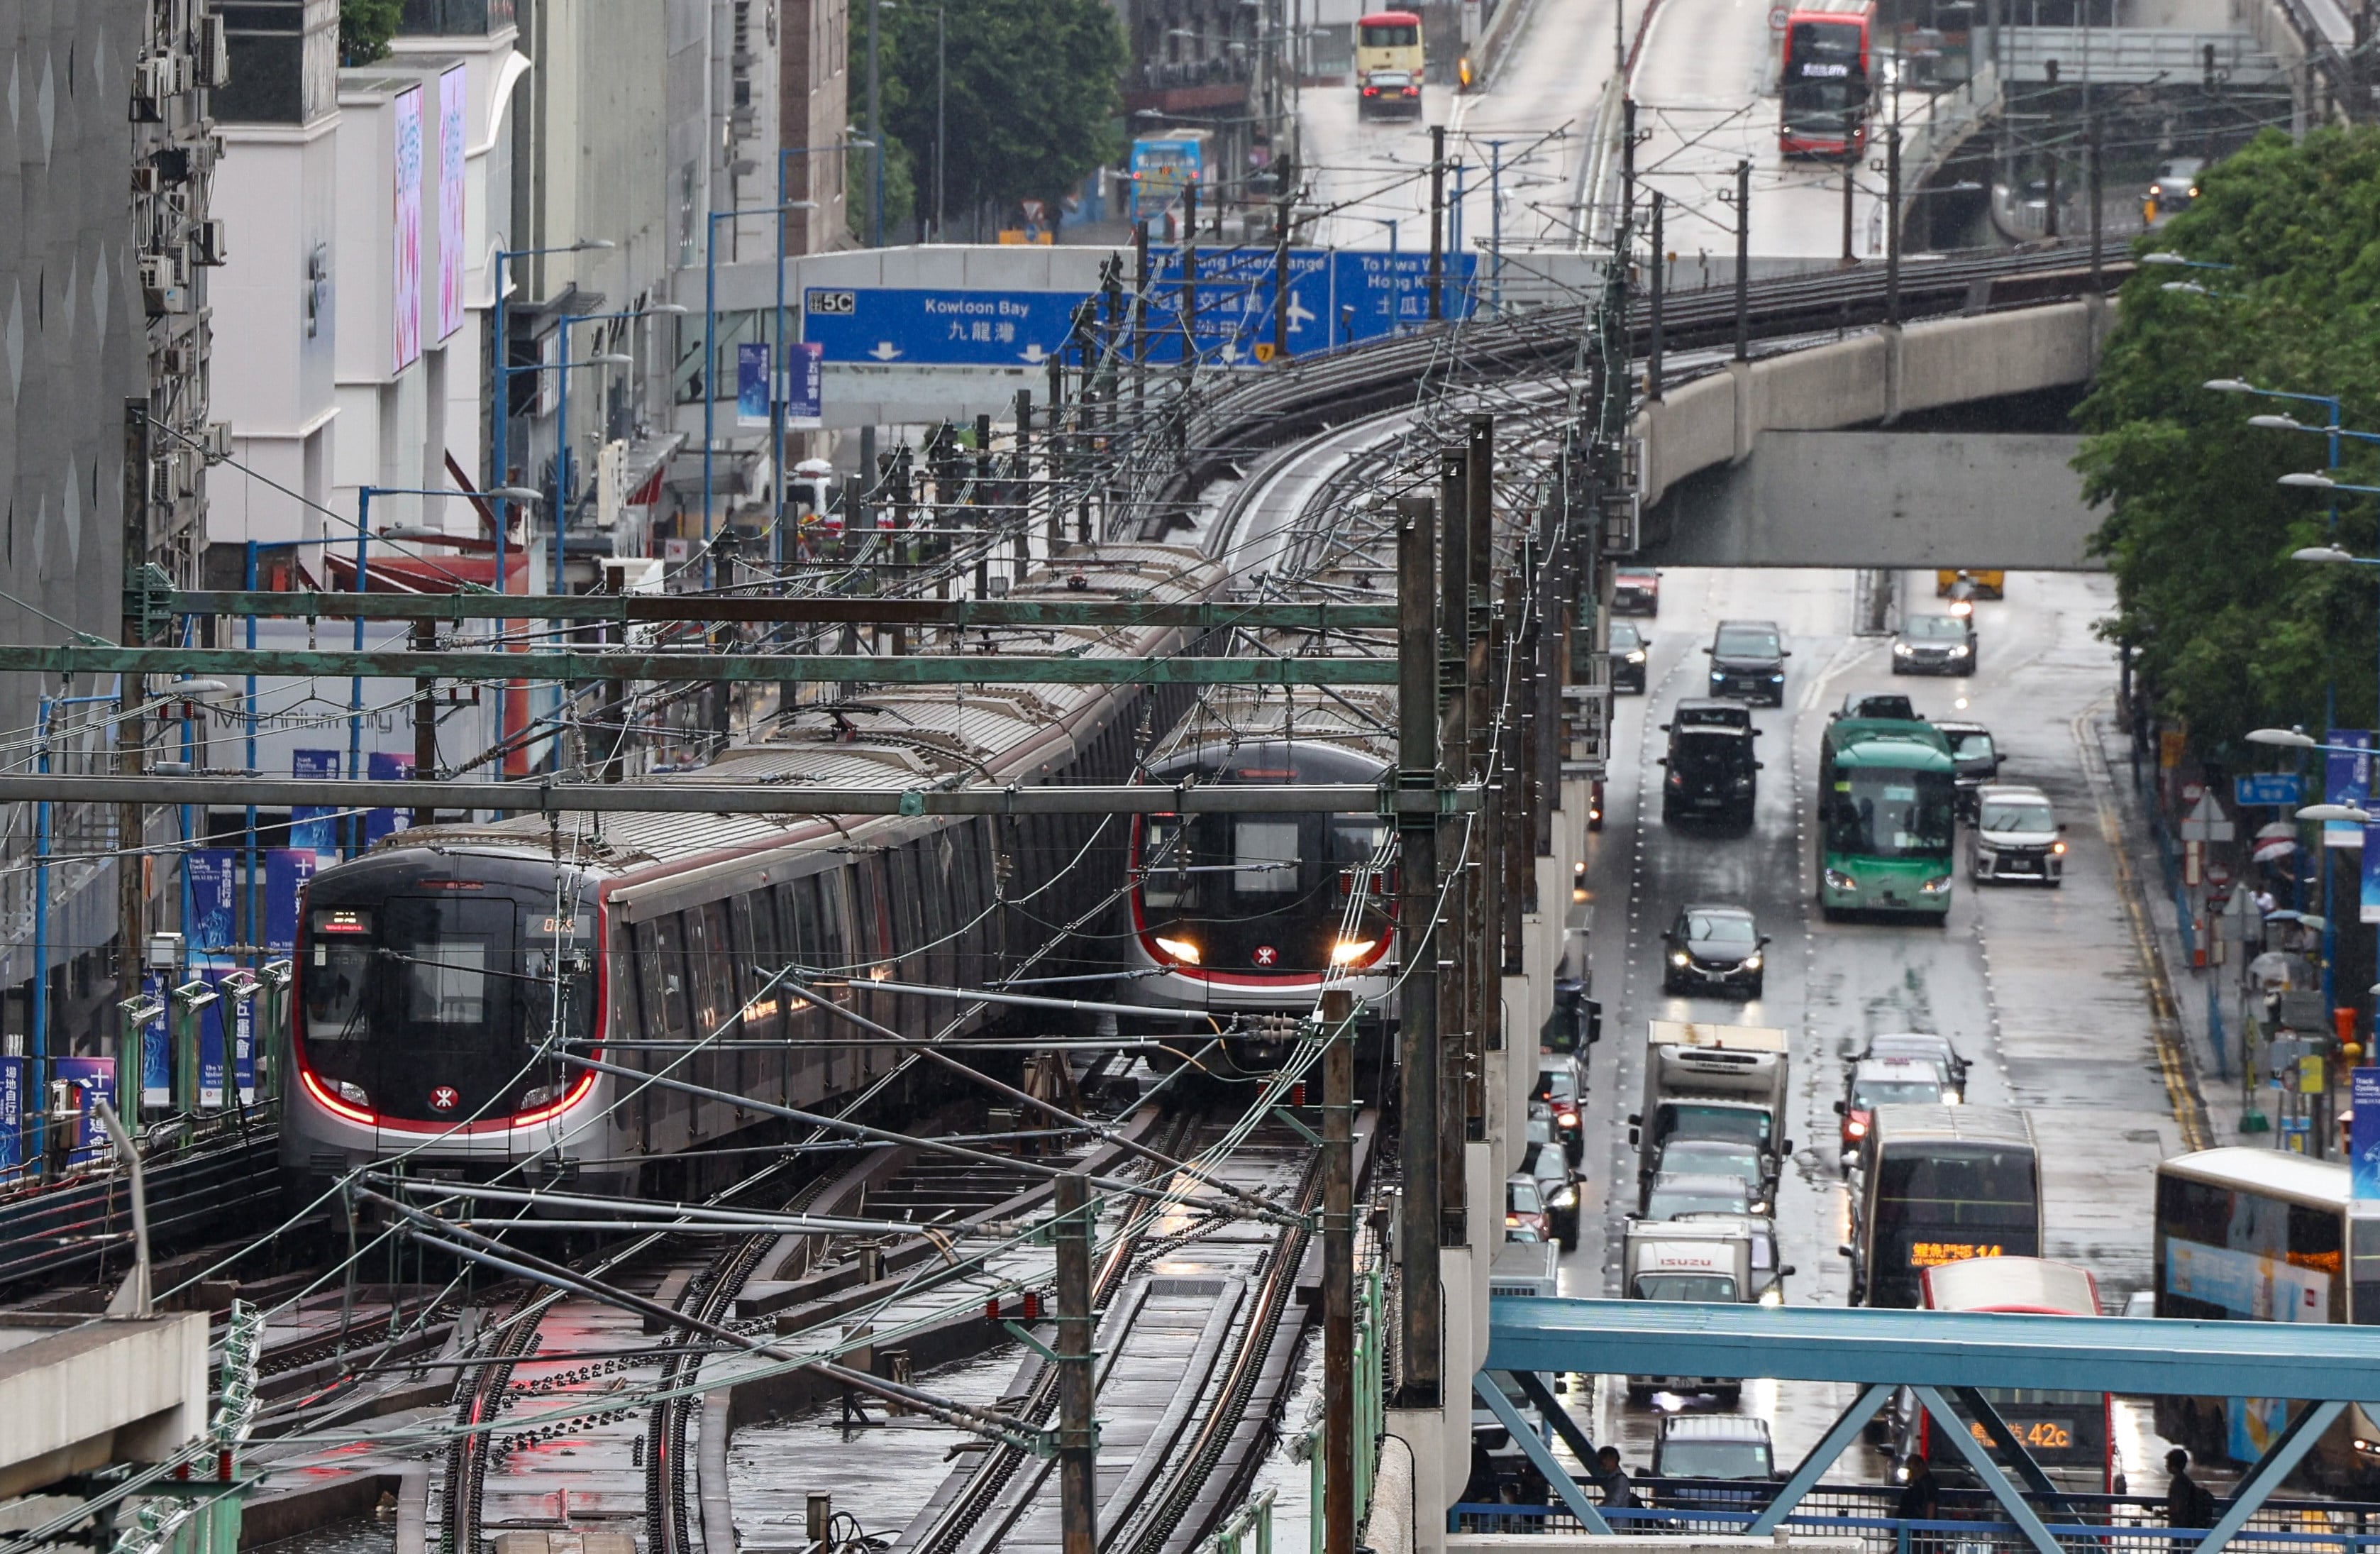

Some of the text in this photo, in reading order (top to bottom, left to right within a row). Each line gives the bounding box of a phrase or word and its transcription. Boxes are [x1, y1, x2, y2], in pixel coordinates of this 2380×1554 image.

[1194, 256, 1227, 271] ung
[1231, 255, 1324, 272] Intercange
[1361, 257, 1379, 270] To
[824, 294, 852, 312] 5C
[925, 298, 1029, 317] Kowloon Bay
[947, 320, 1015, 343] 九龍灣
[1258, 346, 1269, 359] 7
[5, 1065, 17, 1126] 場地自行車
[1660, 1258, 1712, 1267] ISUZU
